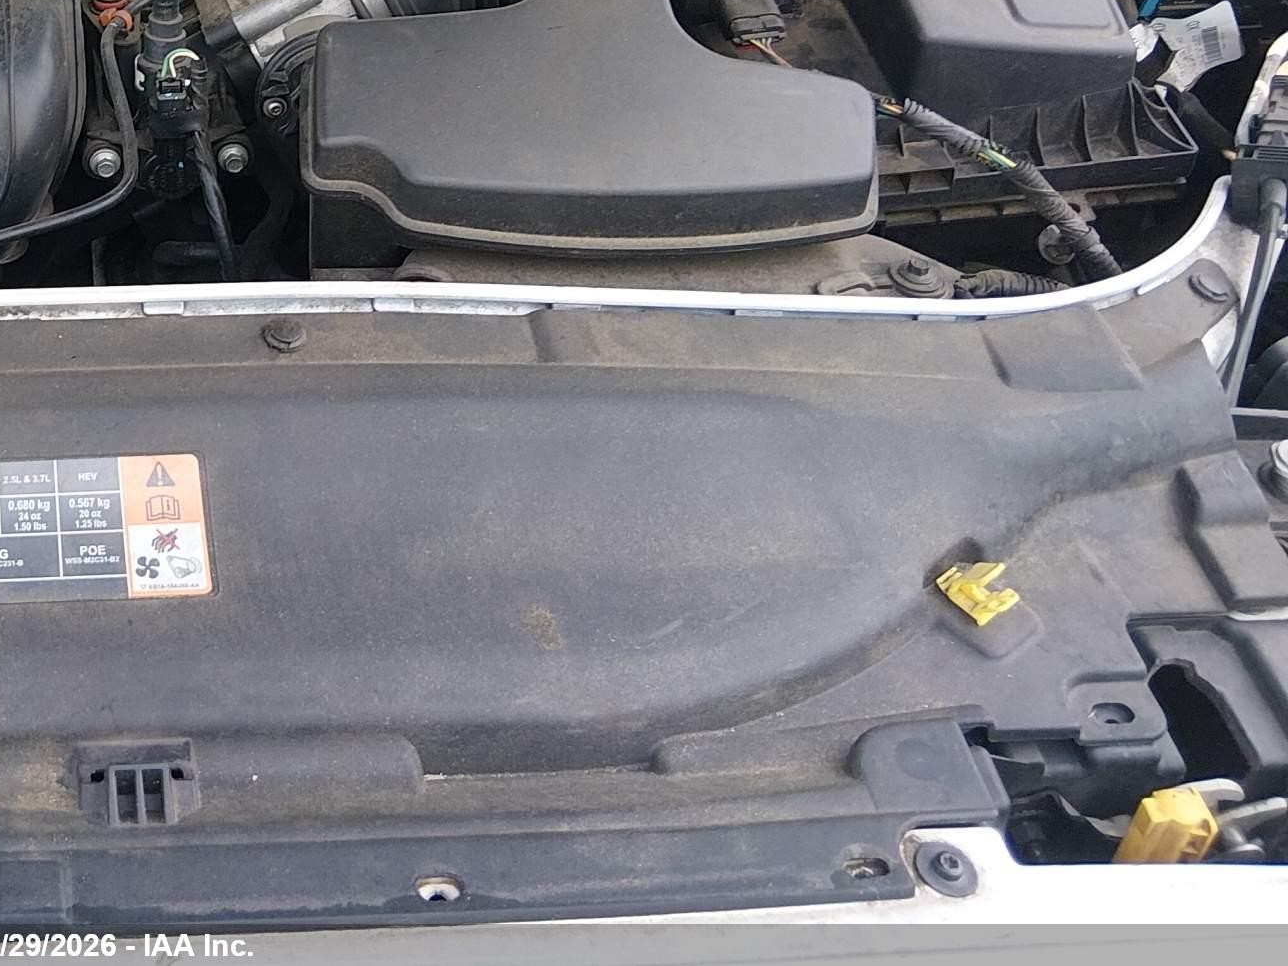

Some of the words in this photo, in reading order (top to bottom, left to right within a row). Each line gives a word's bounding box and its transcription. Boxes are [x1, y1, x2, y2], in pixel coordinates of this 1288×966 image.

[78, 472, 98, 481] HEV
[8, 499, 35, 511] 0.680
[37, 499, 50, 512] kg
[68, 498, 95, 509] 0.567
[97, 497, 110, 510] kg
[18, 512, 29, 521] 24
[79, 509, 89, 518] 20
[14, 522, 31, 531] 1.50
[33, 521, 47, 530] lbs
[75, 519, 92, 529] 1.25
[93, 519, 107, 528] lbs
[79, 545, 107, 556] POE
